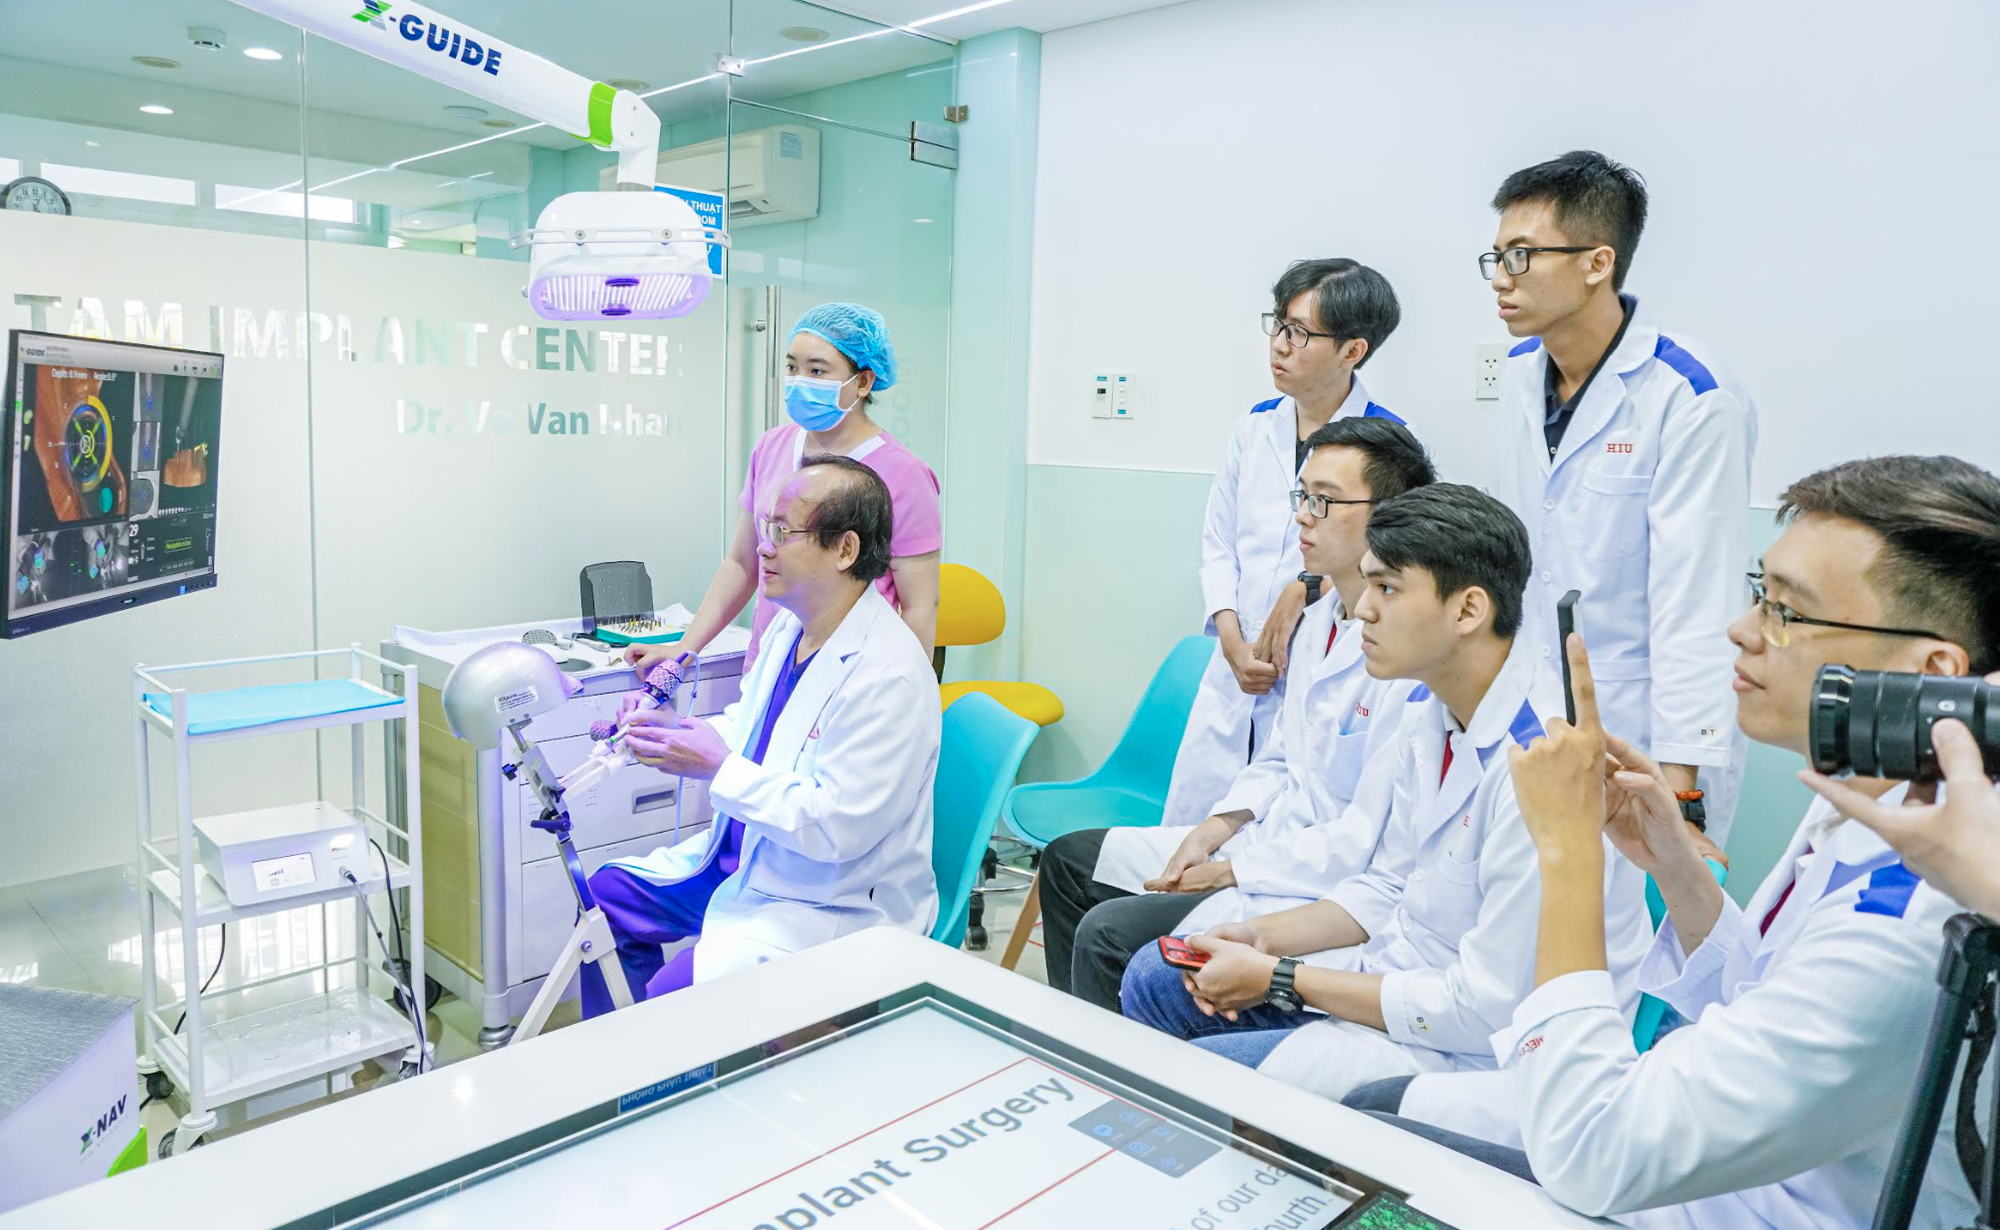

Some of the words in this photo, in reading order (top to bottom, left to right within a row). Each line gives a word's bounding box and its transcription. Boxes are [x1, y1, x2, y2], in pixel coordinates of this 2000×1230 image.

[351, 0, 502, 76] X-GUIDE
[14, 293, 183, 349] TAM
[209, 305, 488, 367] IMPLANT
[396, 399, 454, 435] Dr.
[527, 402, 589, 436] Van
[1606, 443, 1633, 454] HIU
[129, 524, 140, 538] 29
[80, 1093, 127, 1156] X-NAV
[752, 1157, 912, 1230] plant
[902, 1077, 1075, 1163] Surgery
[1191, 1206, 1223, 1230] of
[1216, 1182, 1260, 1213] our
[1254, 1164, 1288, 1186] da
[1252, 1195, 1334, 1230] urth.
